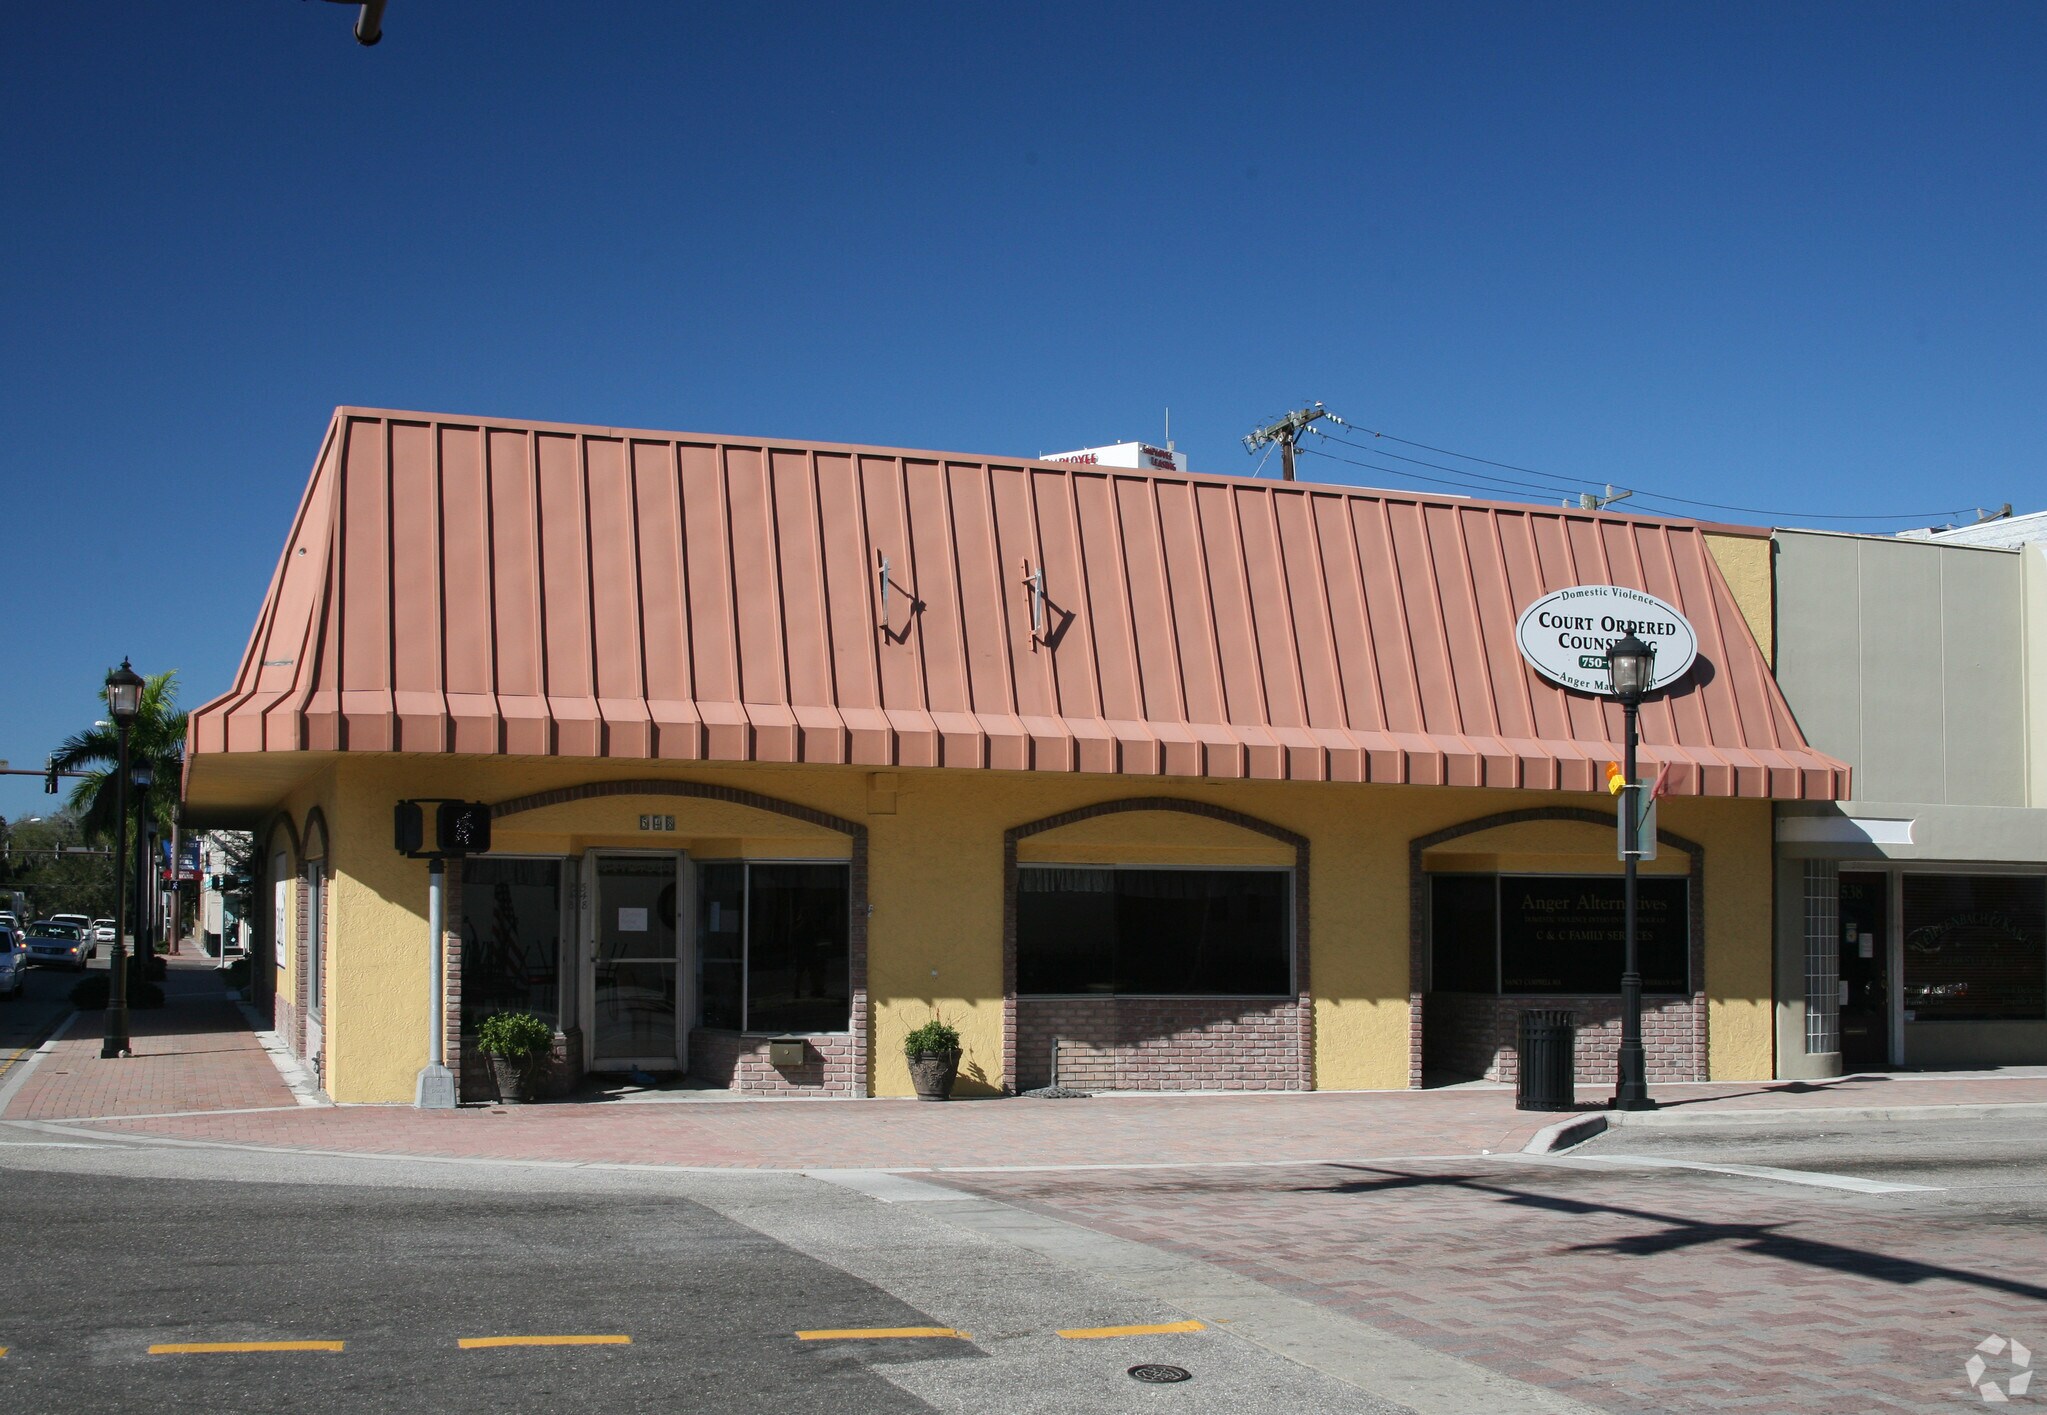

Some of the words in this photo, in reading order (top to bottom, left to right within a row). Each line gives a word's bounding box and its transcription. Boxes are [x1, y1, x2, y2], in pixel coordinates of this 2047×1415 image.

[1561, 587, 1608, 601] Domestic
[1612, 588, 1654, 606] Violence
[1538, 611, 1594, 631] COURT
[1559, 671, 1591, 688] Anger
[1521, 894, 1570, 912] Anger
[1576, 894, 1668, 910] Alterntives
[1536, 930, 1544, 941] C
[1546, 930, 1556, 941] &
[1558, 930, 1566, 941] C
[1569, 930, 1605, 941] FAMILY
[1607, 930, 1655, 941] SERCES
